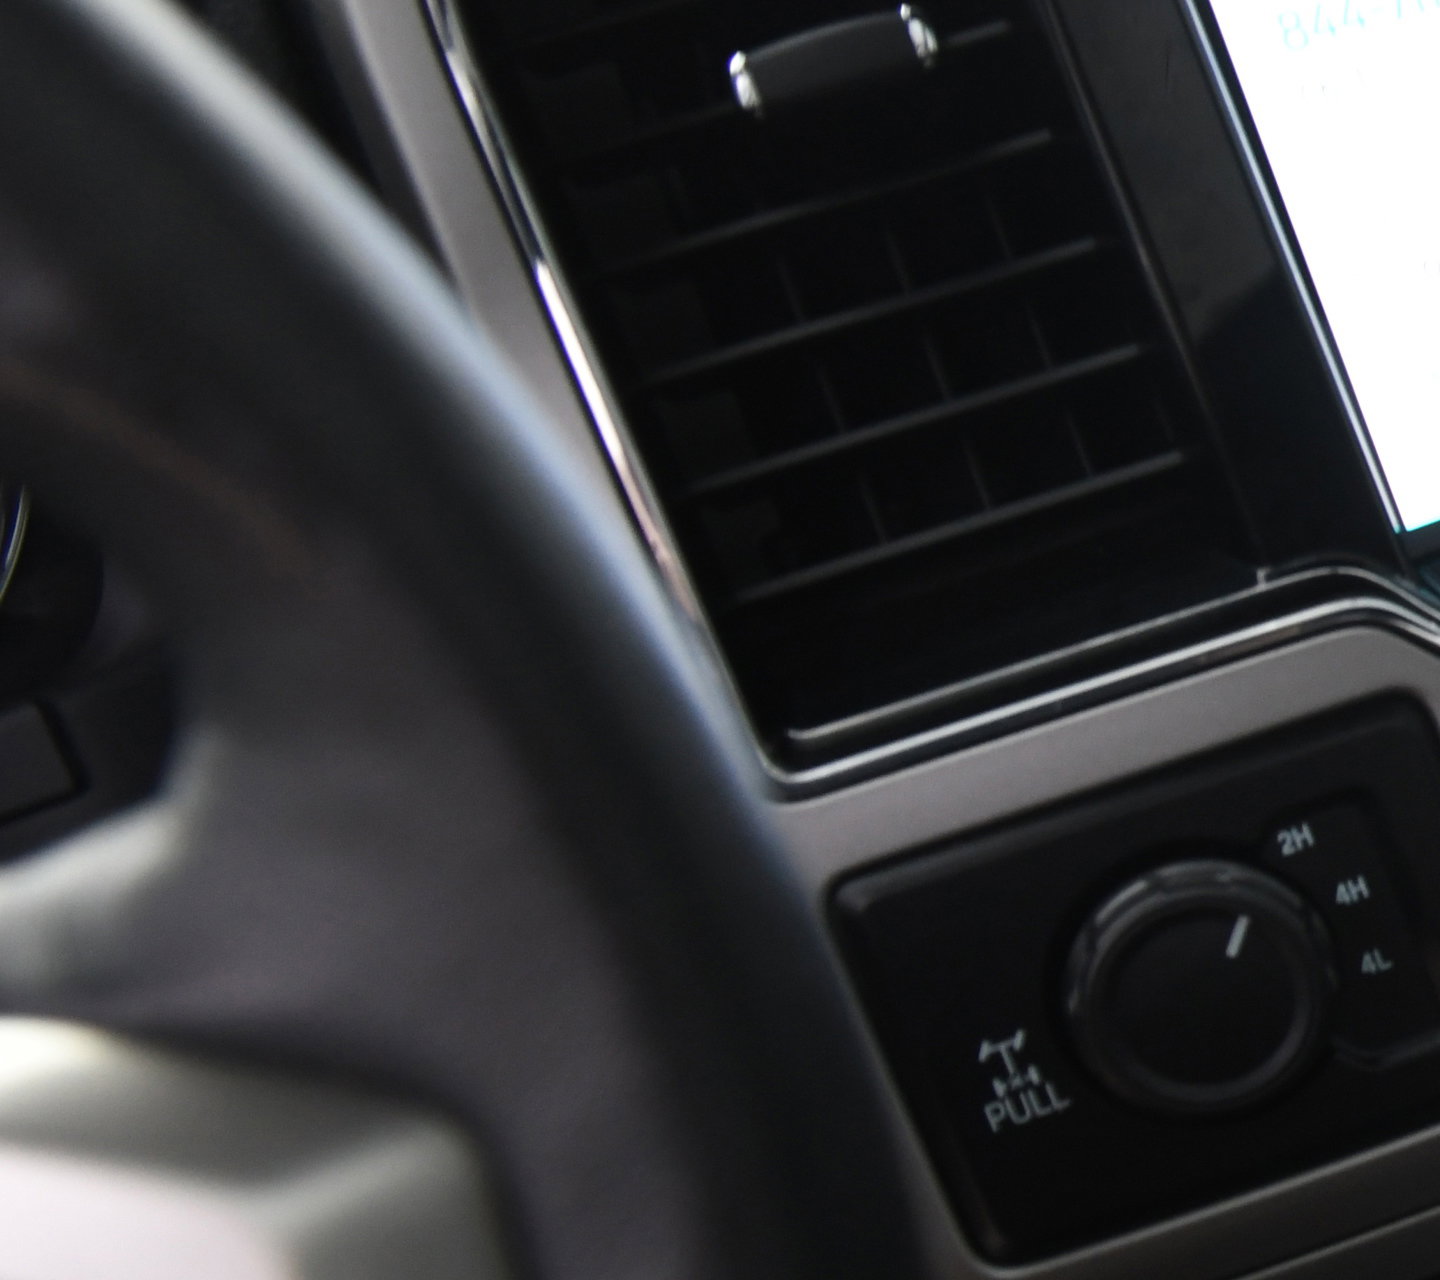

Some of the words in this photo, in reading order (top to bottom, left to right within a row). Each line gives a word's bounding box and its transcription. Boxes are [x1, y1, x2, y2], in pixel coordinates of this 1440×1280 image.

[1277, 822, 1314, 856] 2H
[1335, 875, 1369, 905] 4H
[1361, 948, 1393, 975] 4L
[984, 1083, 1072, 1133] PULL
